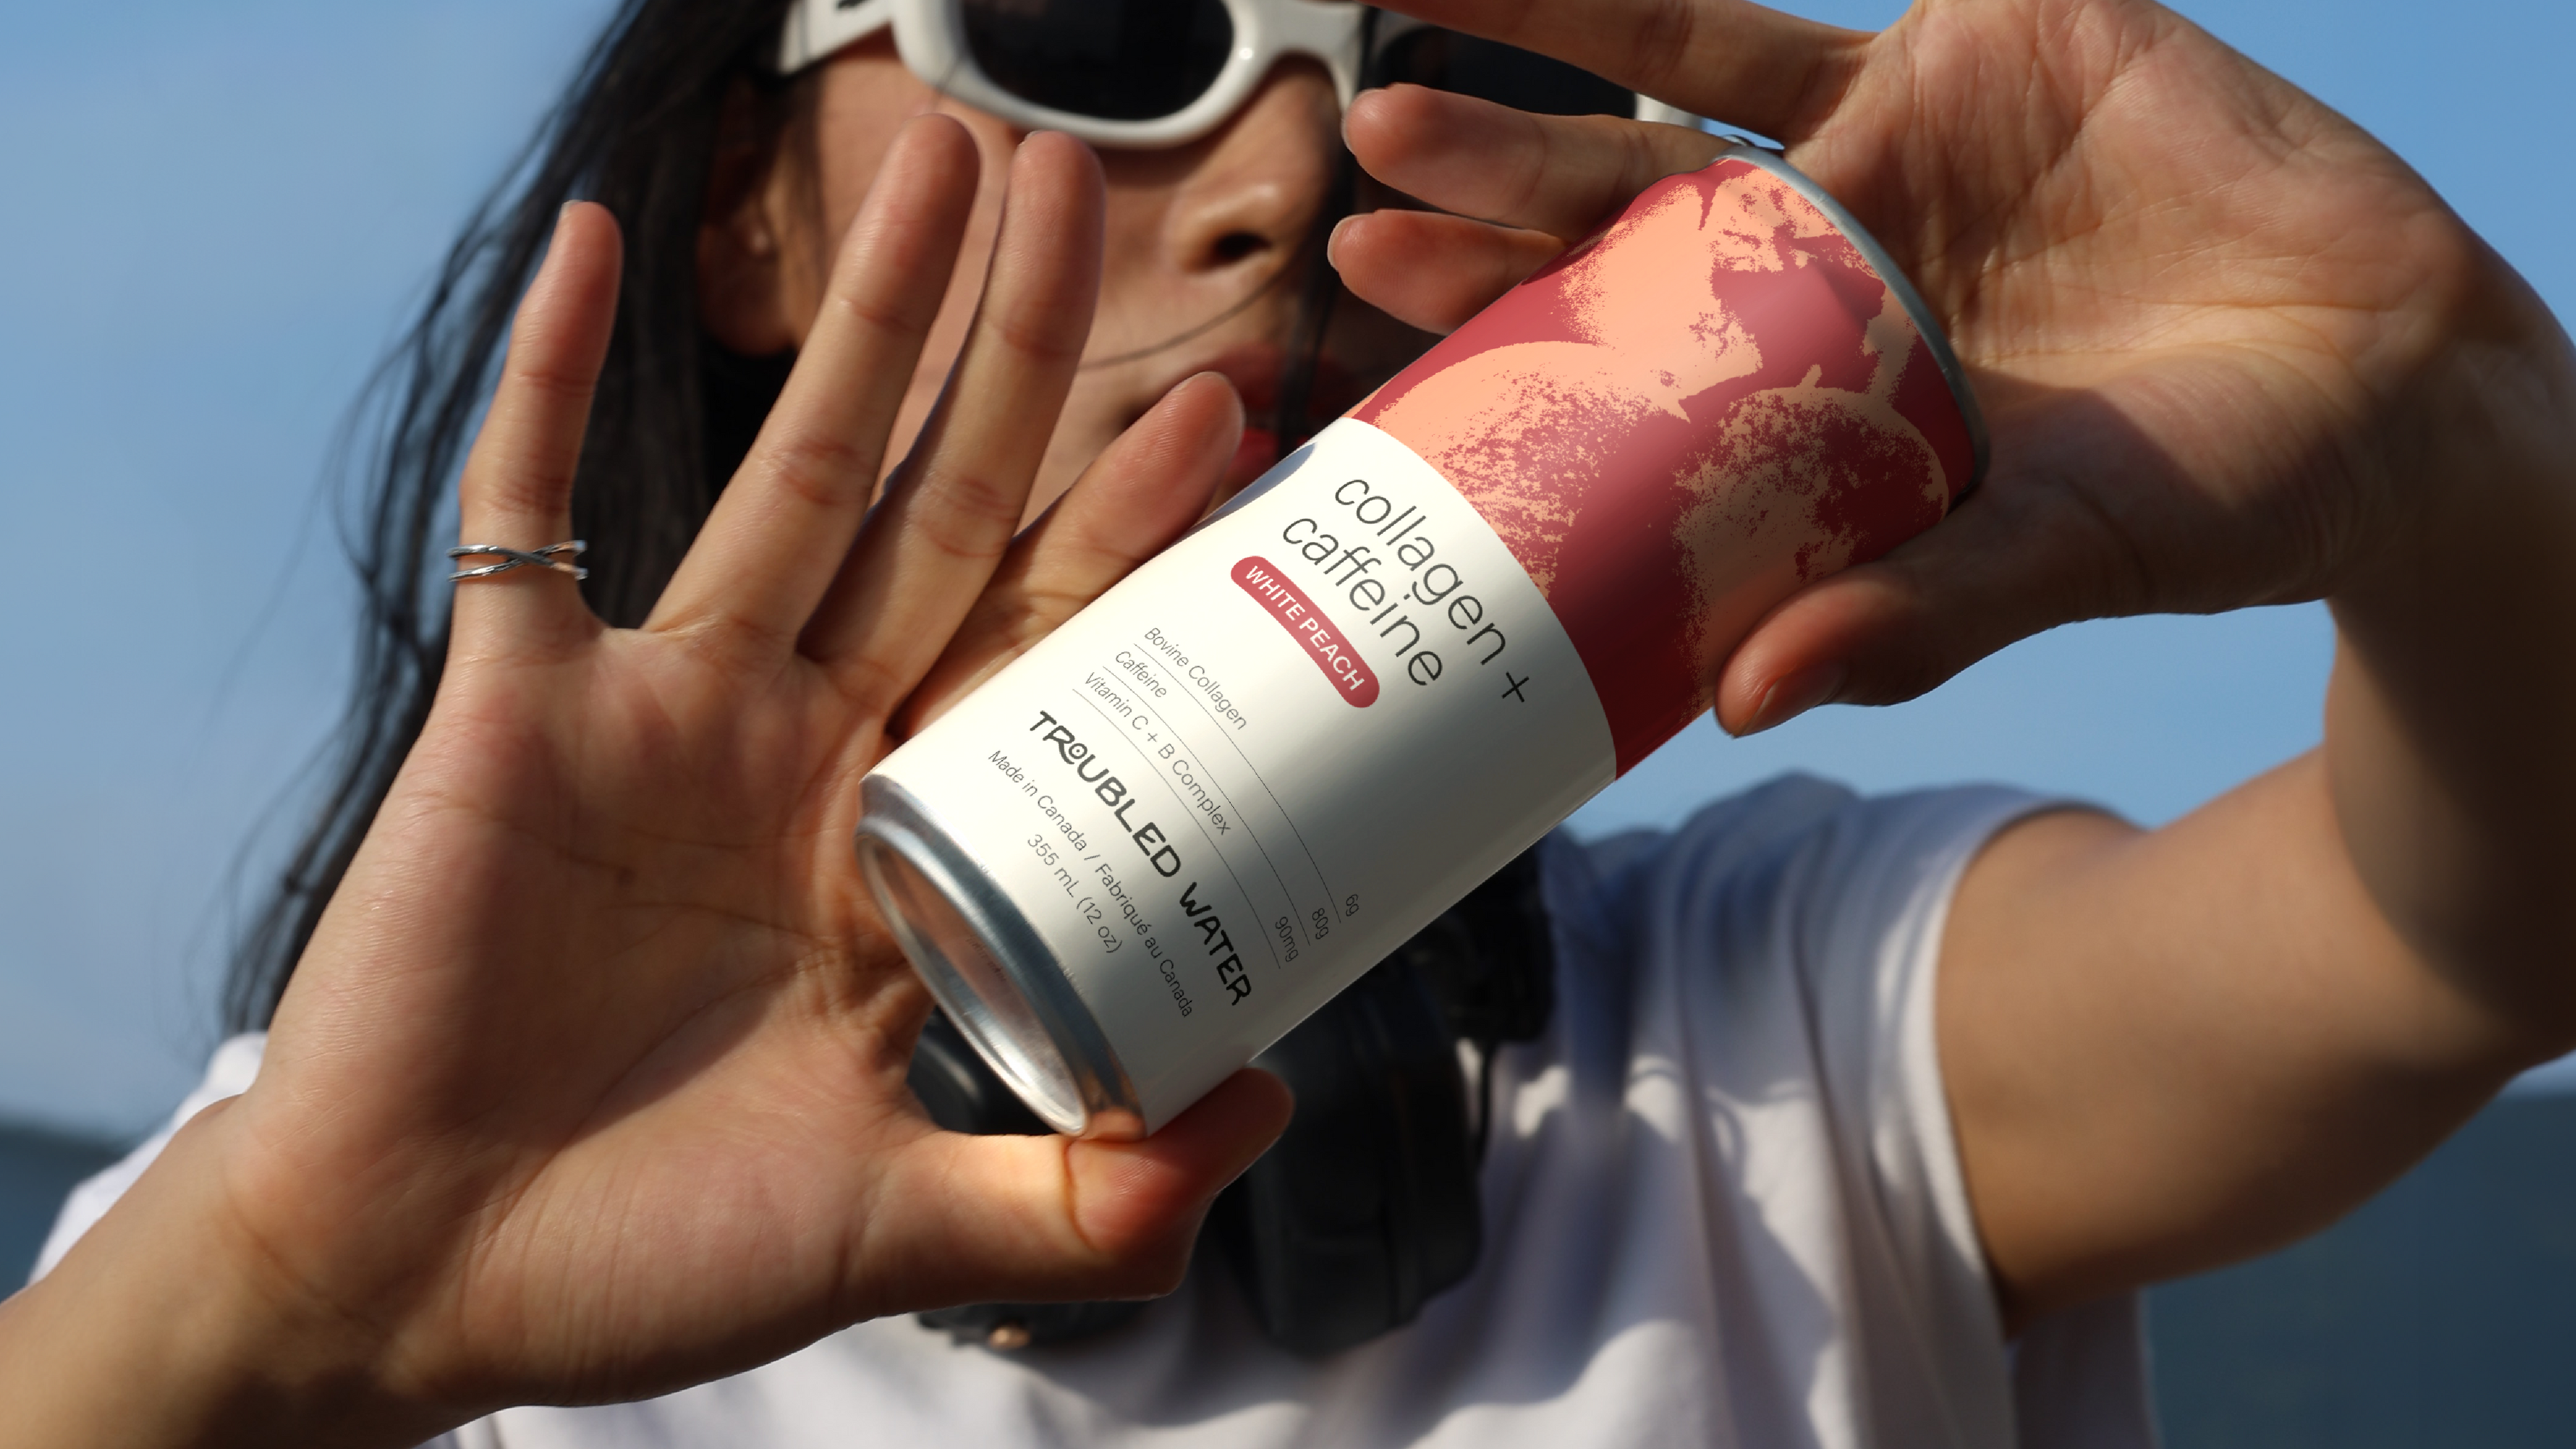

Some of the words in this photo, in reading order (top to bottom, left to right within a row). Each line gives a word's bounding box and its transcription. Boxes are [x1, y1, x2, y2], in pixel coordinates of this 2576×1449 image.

[1246, 566, 1306, 621] WHITE
[1299, 617, 1364, 690] PEACH
[1283, 518, 1443, 686] caffeine
[1334, 479, 1506, 665] collagen
[1501, 671, 1529, 703] +
[987, 750, 1024, 783] Made
[1022, 780, 1038, 797] in
[1037, 795, 1087, 852] Canada
[1094, 863, 1152, 935] Fabriqué
[1144, 936, 1163, 959] au
[1159, 959, 1193, 1018] Canada
[1027, 834, 1060, 866] 355
[1053, 867, 1079, 898] mL
[1076, 897, 1102, 925] (12
[1097, 926, 1122, 954] oz)
[1029, 710, 1181, 877] TROUBLED
[1179, 881, 1252, 1006] WATER
[1085, 672, 1132, 718] Vitamin
[1132, 715, 1148, 731] C
[1147, 733, 1158, 743] +
[1157, 743, 1175, 759] B
[1172, 759, 1231, 835] Complex
[1275, 916, 1299, 963] 90mg
[1115, 651, 1167, 698] Caffeine
[1311, 908, 1329, 940] 80g
[1144, 627, 1189, 667] Bovine
[1188, 665, 1247, 731] Collagen
[1345, 894, 1360, 917] 6g
